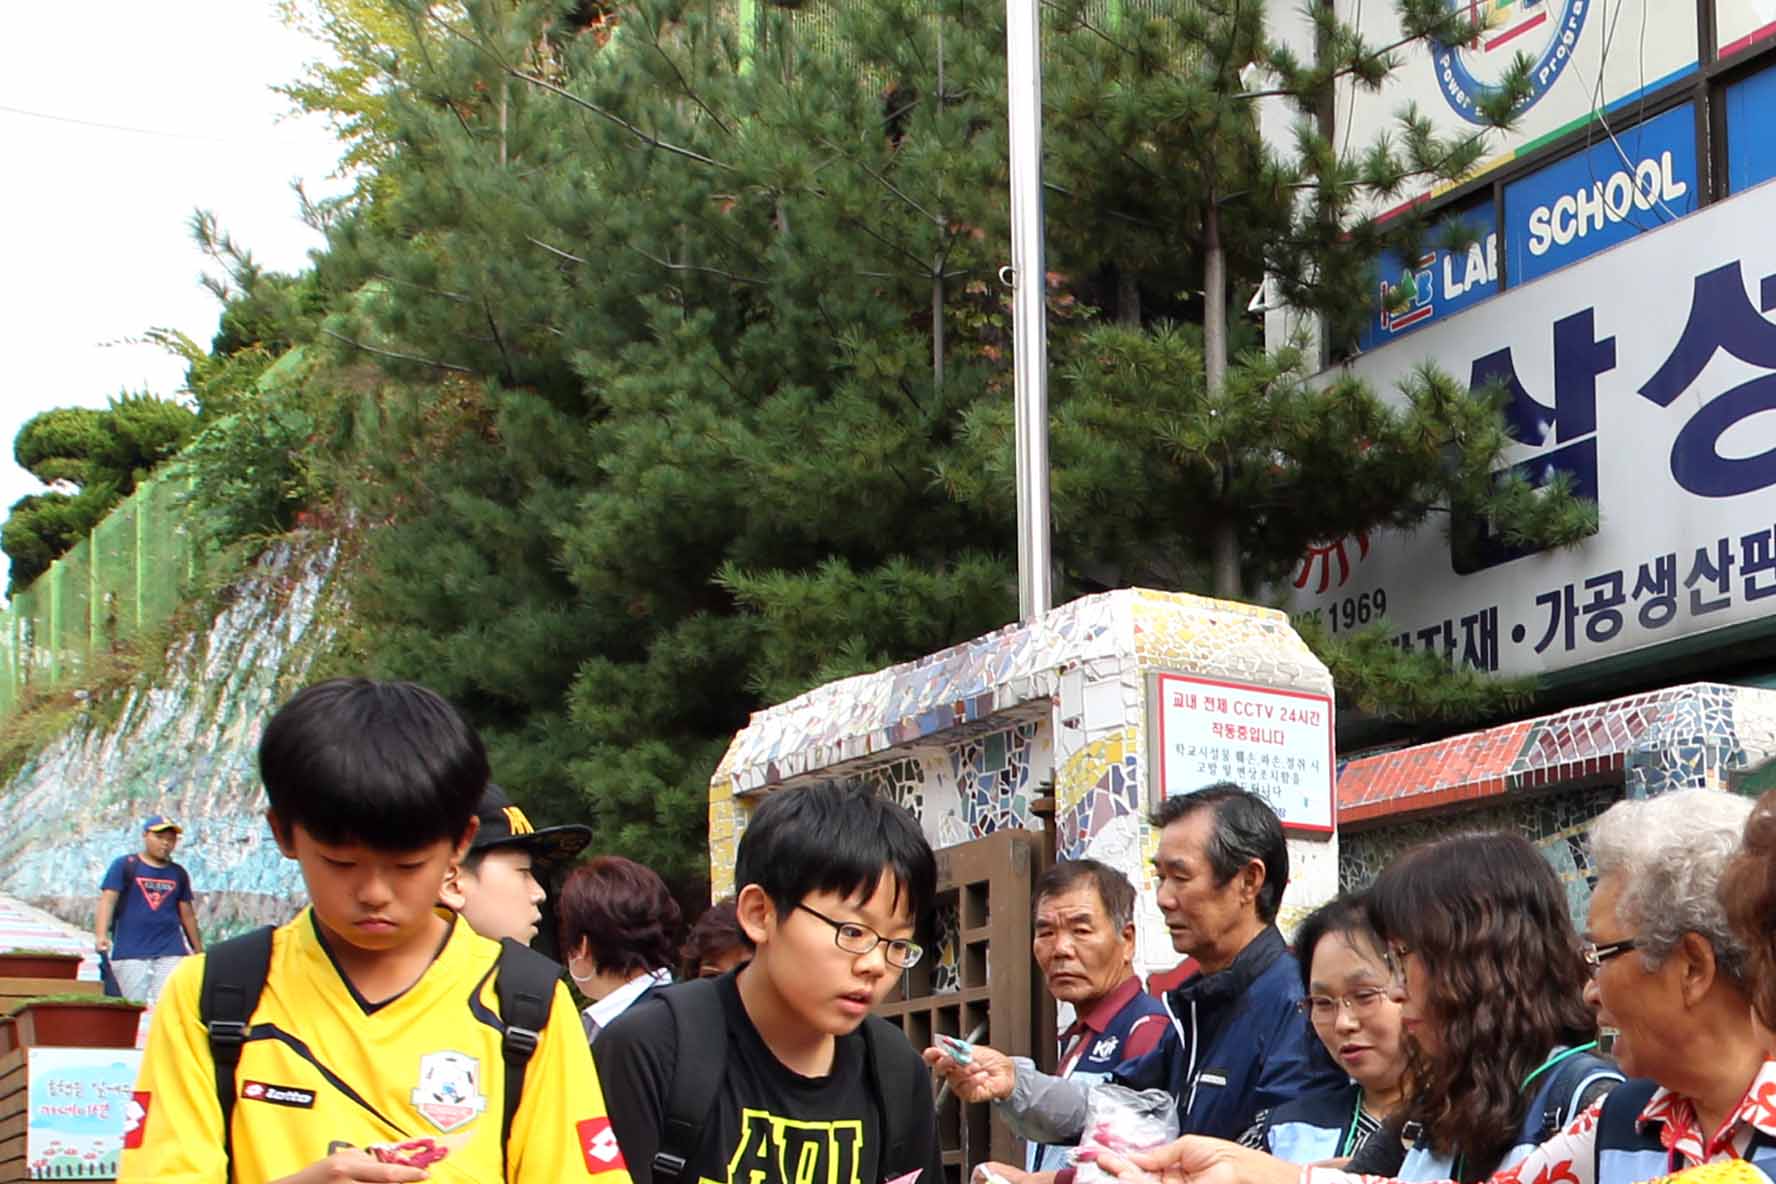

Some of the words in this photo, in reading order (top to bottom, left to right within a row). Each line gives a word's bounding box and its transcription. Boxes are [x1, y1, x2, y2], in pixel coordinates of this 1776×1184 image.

[1529, 151, 1687, 256] SCHOOL
[1329, 588, 1386, 632] 1969
[1173, 692, 1198, 710] 교내
[1204, 696, 1228, 714] 전체
[1233, 701, 1274, 719] CCTV
[1280, 708, 1321, 726] 24시간
[1212, 722, 1285, 746] 작동중입니다
